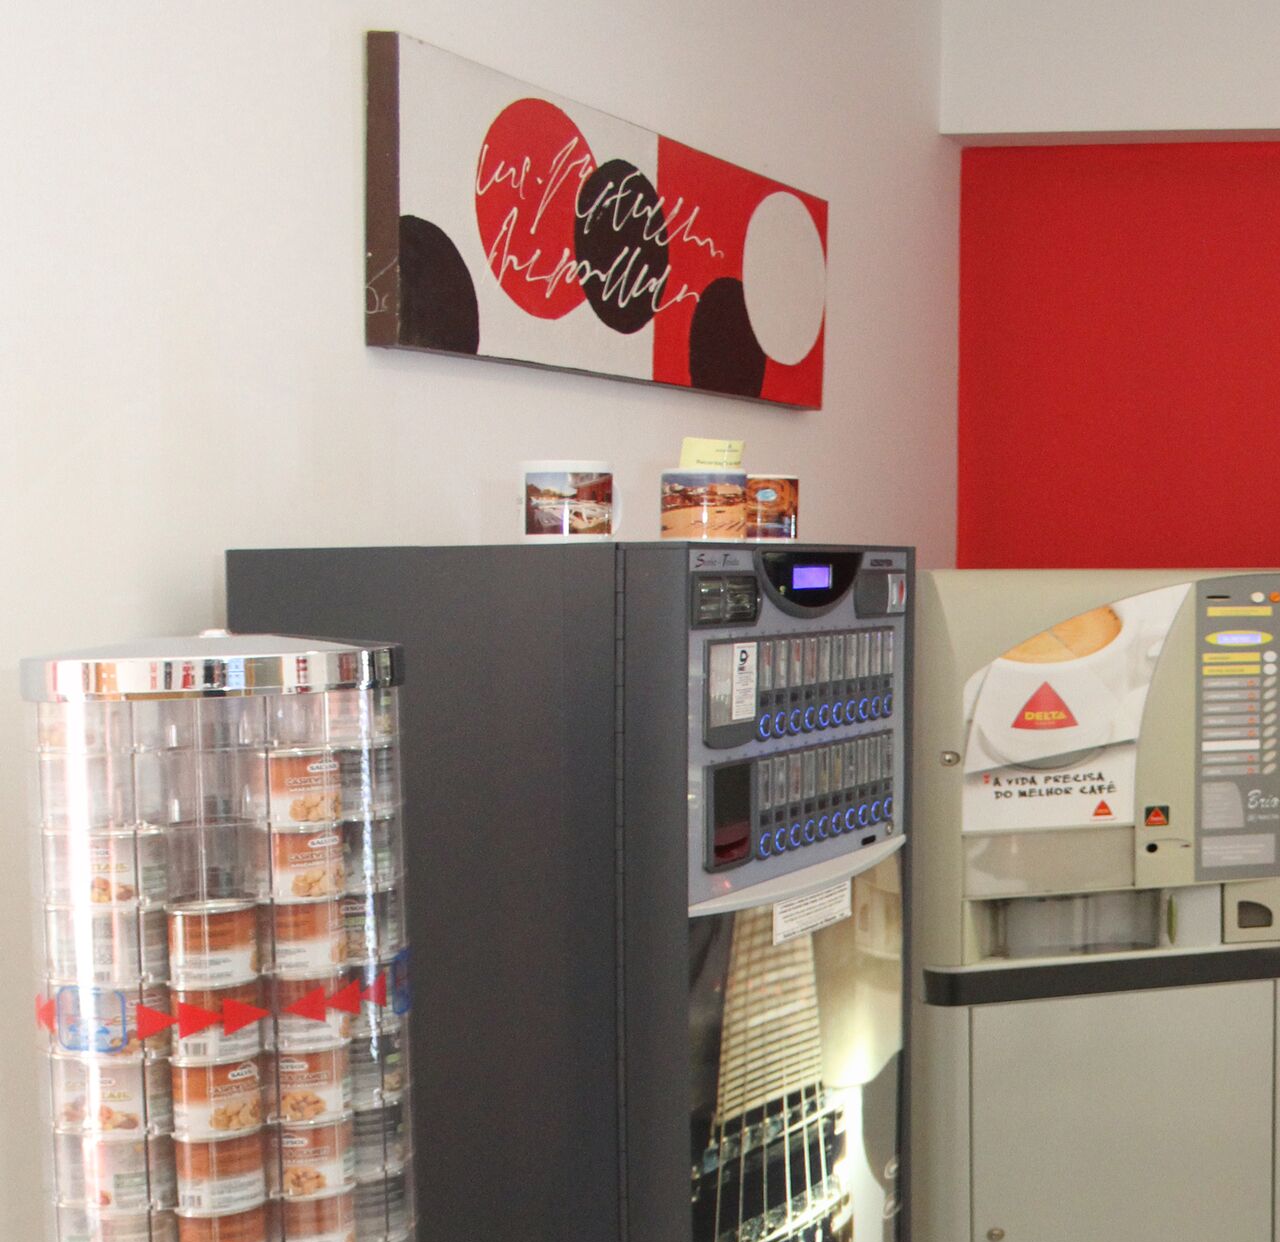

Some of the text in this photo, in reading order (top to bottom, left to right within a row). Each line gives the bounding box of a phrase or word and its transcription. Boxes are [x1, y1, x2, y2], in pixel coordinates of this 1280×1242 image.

[1024, 710, 1067, 722] DELTA
[993, 772, 1105, 787] A VIDA PRECISA
[994, 781, 1117, 800] DO MELHOR CAFÉ
